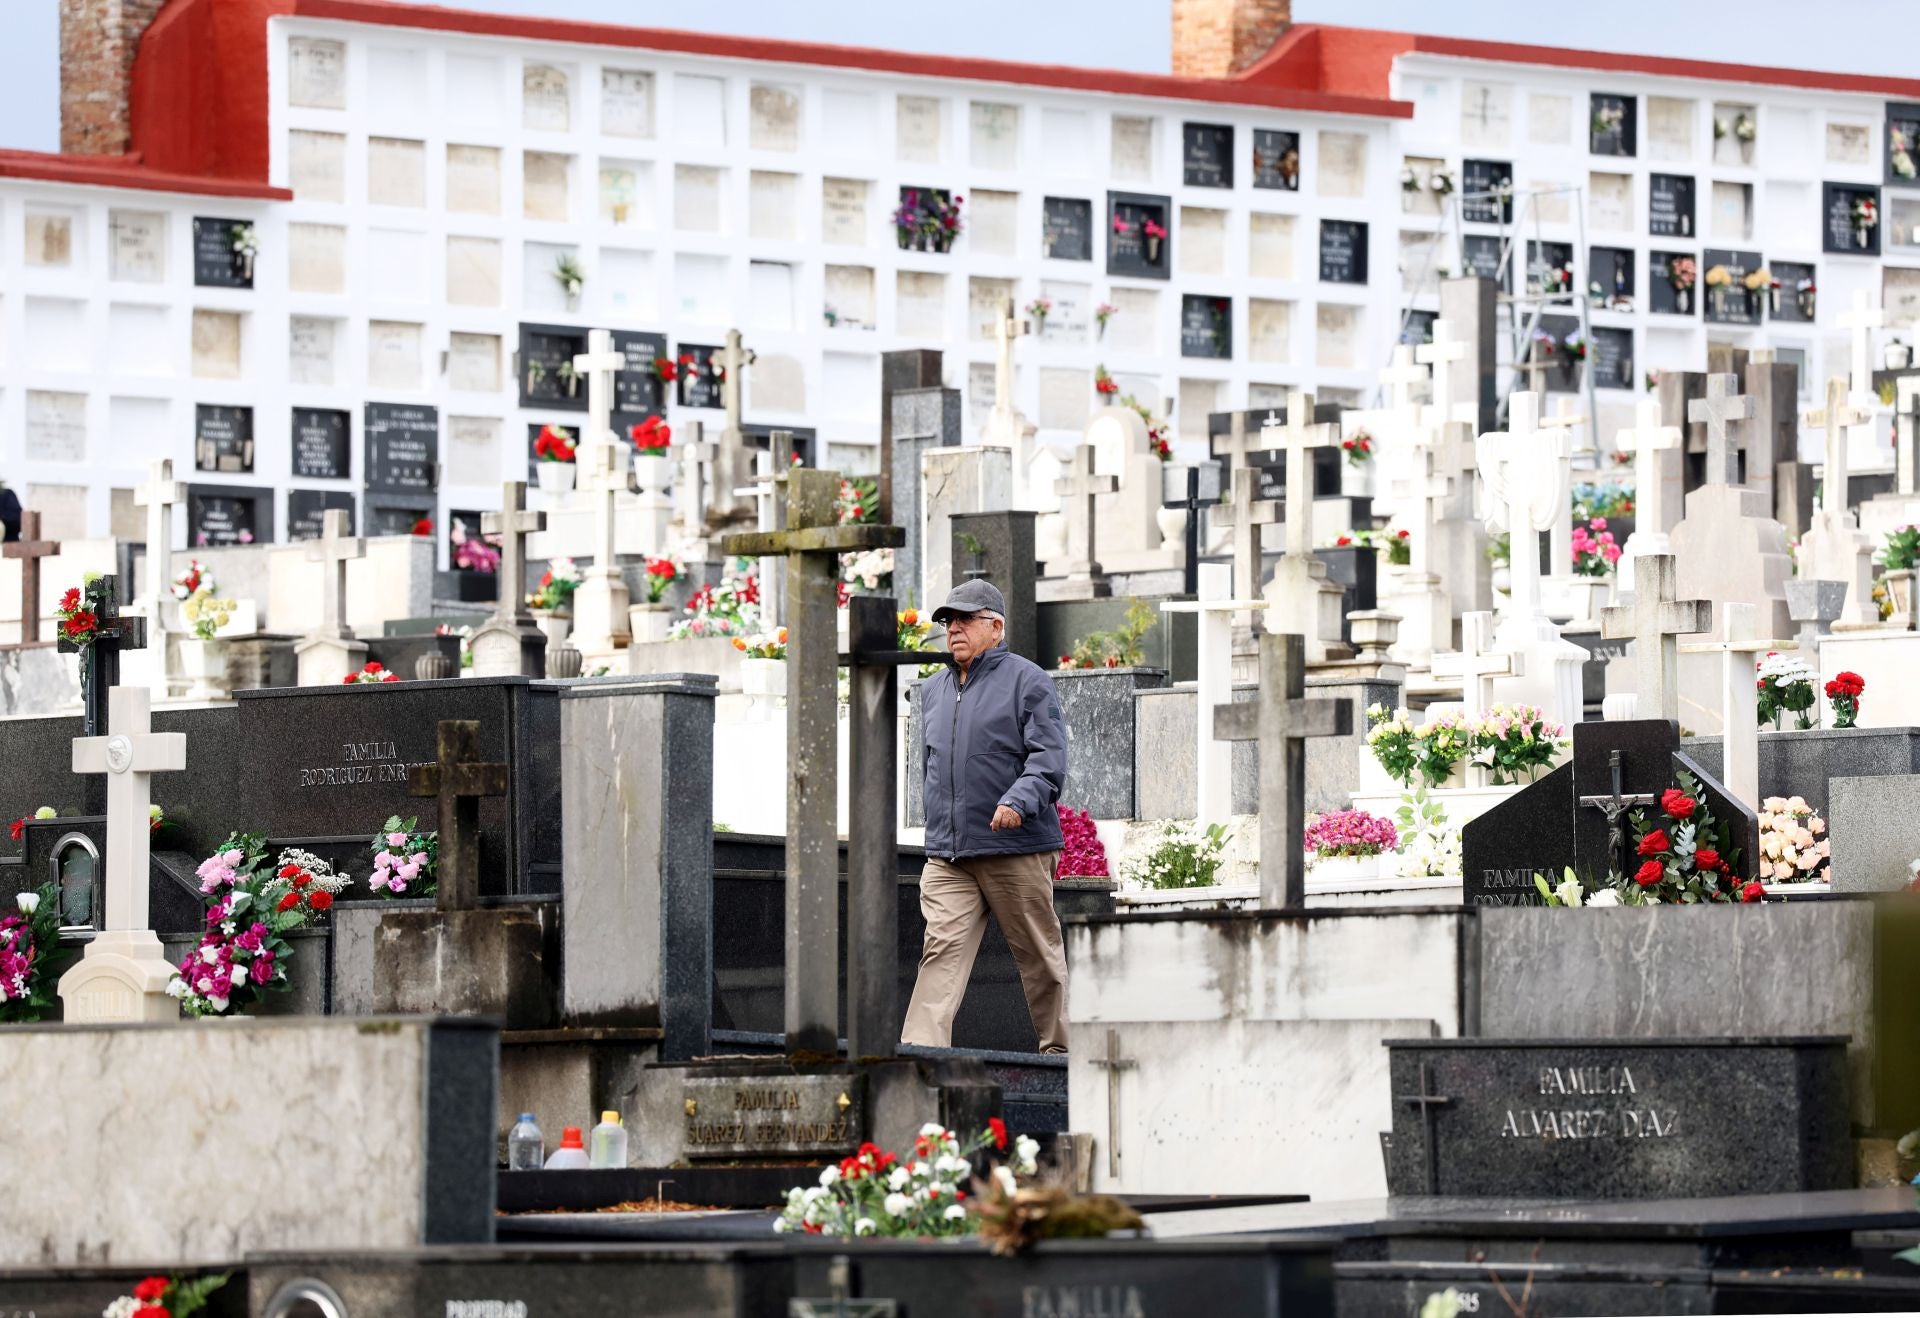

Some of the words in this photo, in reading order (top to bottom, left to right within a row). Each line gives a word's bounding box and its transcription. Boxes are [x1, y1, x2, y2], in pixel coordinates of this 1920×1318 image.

[342, 741, 397, 762] FAMILIA
[300, 767, 373, 787] RODRIGUEZ
[1540, 1066, 1637, 1095] FAMILIA
[734, 1089, 800, 1111] FAMILIA
[687, 1124, 746, 1145] SUAREZ
[755, 1121, 848, 1143] FERNANDEZ
[1501, 1109, 1608, 1139] ALVAREZ
[1624, 1109, 1680, 1138] DIAZ
